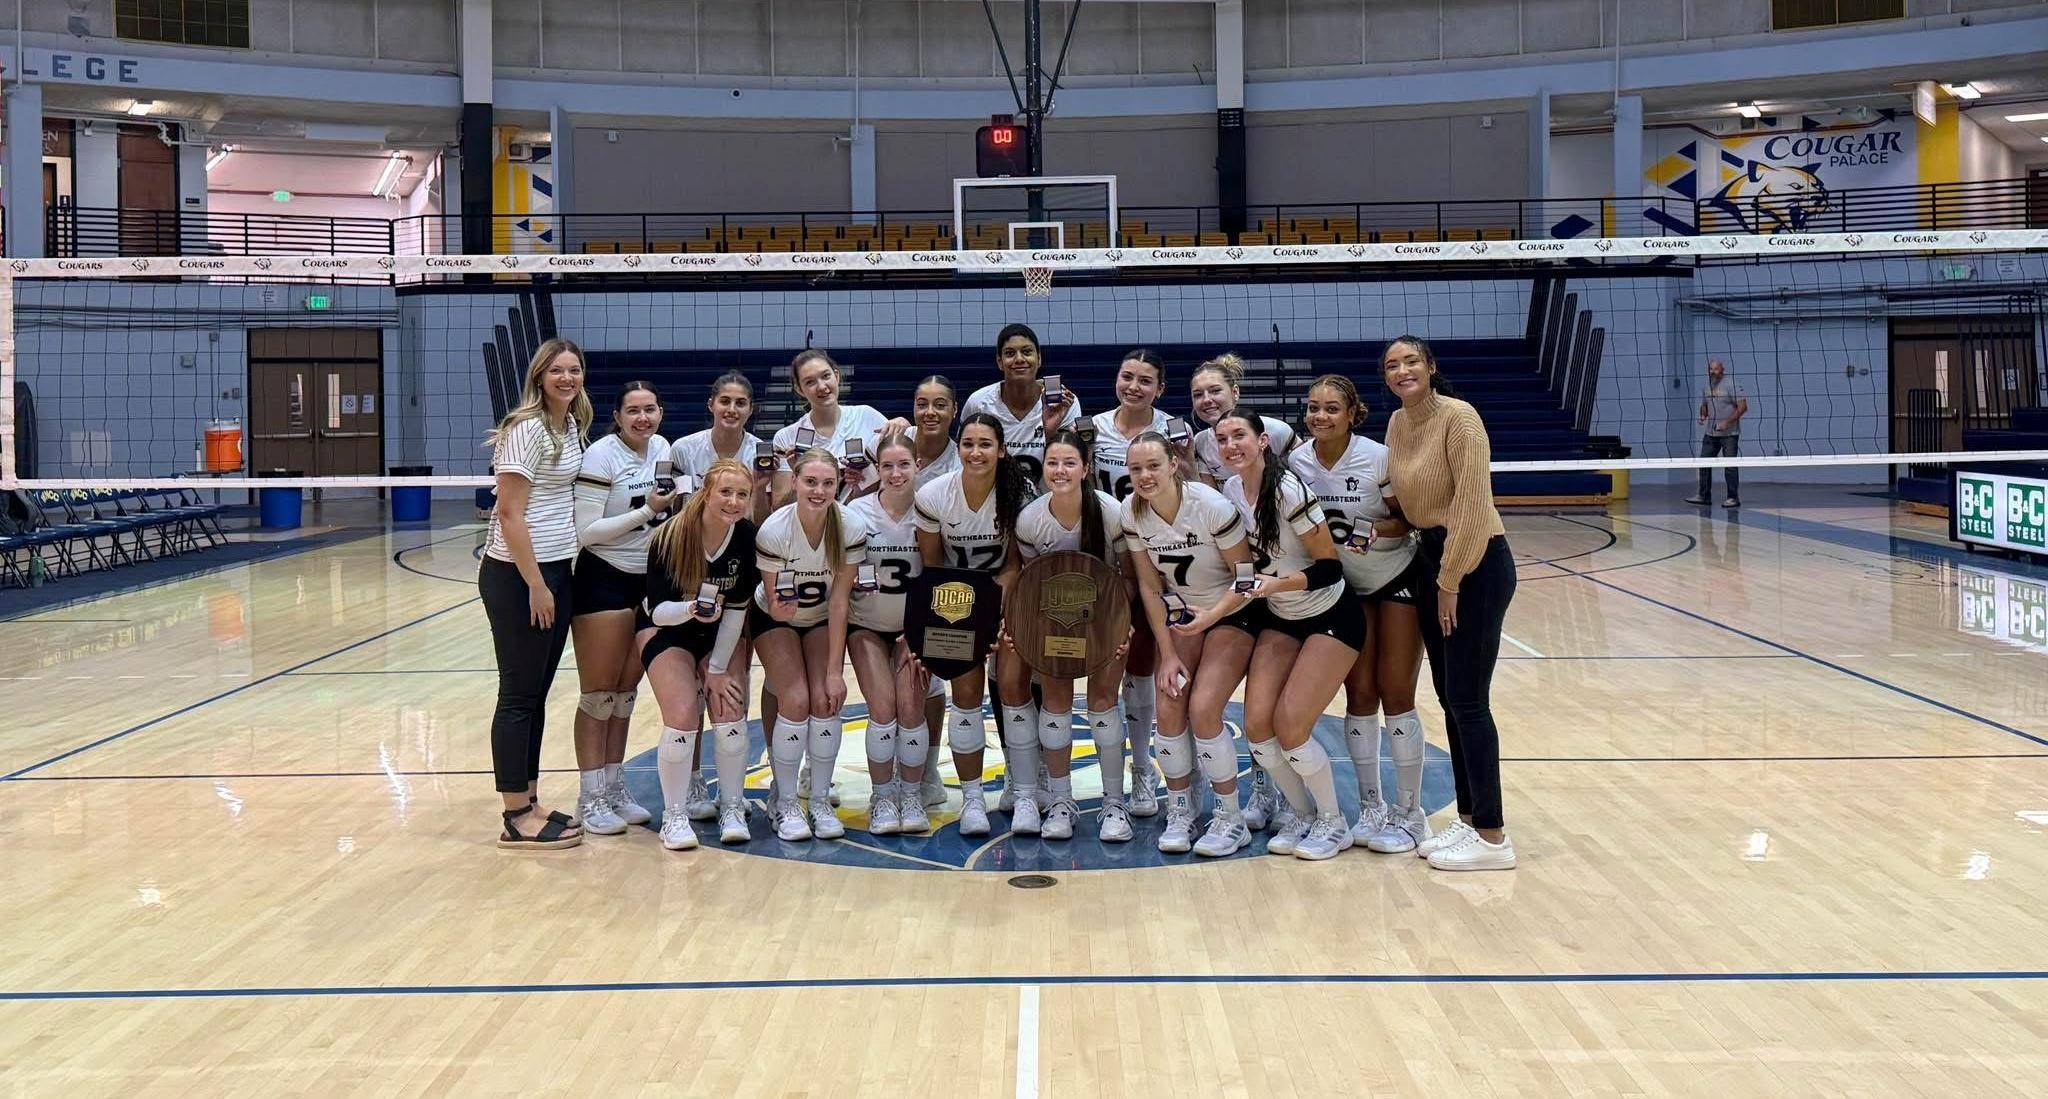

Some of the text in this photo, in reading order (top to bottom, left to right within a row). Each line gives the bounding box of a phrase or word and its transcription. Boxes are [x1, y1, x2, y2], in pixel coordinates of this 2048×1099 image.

[1764, 131, 1904, 160] COUGAR
[1831, 152, 1888, 167] PALACE
[57, 234, 1941, 270] COUGARS COUGARS COUGARS COUGARS COUGARS COUGARS COUGARS COUGARS COUGARS COUGARS COUGARS COUGARS COUGARS COUGARS COUGARS COUGARS
[1960, 482, 1993, 518] B&C
[2008, 487, 2044, 526] B&C
[1961, 518, 1993, 534] STEEL
[2008, 525, 2044, 542] STEEL
[879, 559, 911, 594] 3
[1158, 555, 1195, 586] 7
